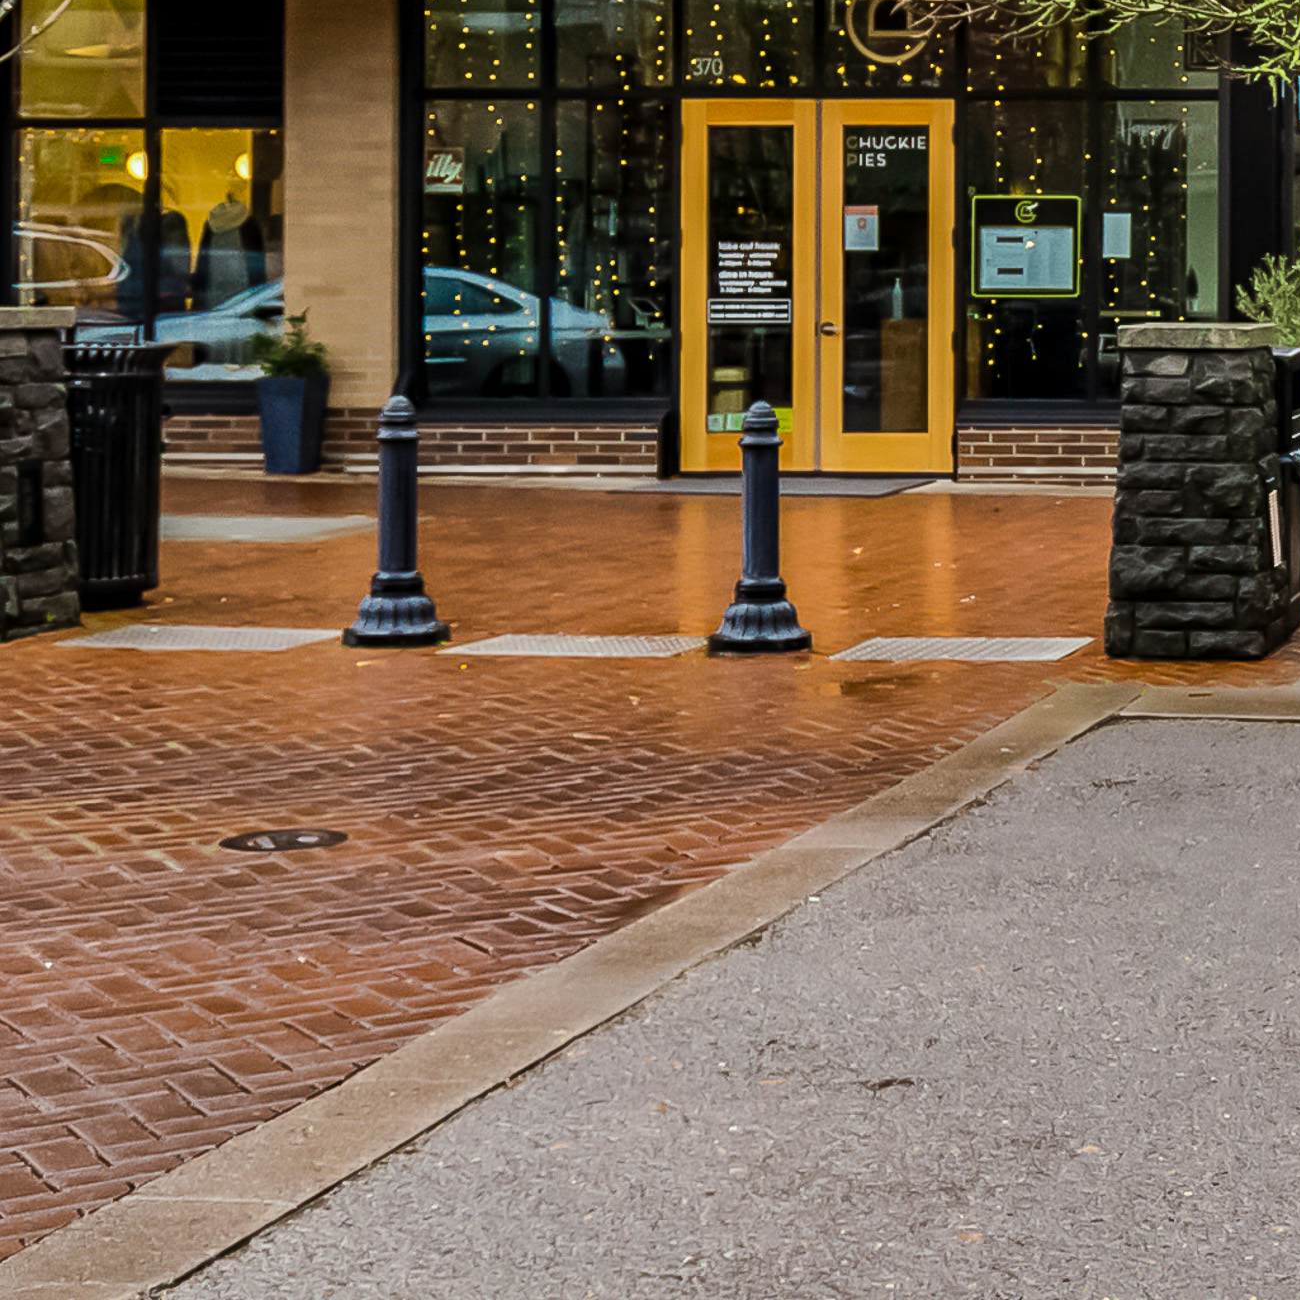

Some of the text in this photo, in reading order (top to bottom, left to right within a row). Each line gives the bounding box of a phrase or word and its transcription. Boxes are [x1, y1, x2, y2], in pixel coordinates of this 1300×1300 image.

[691, 58, 723, 76] 370
[846, 135, 927, 150] CHUCKIE
[846, 153, 887, 167] PIES
